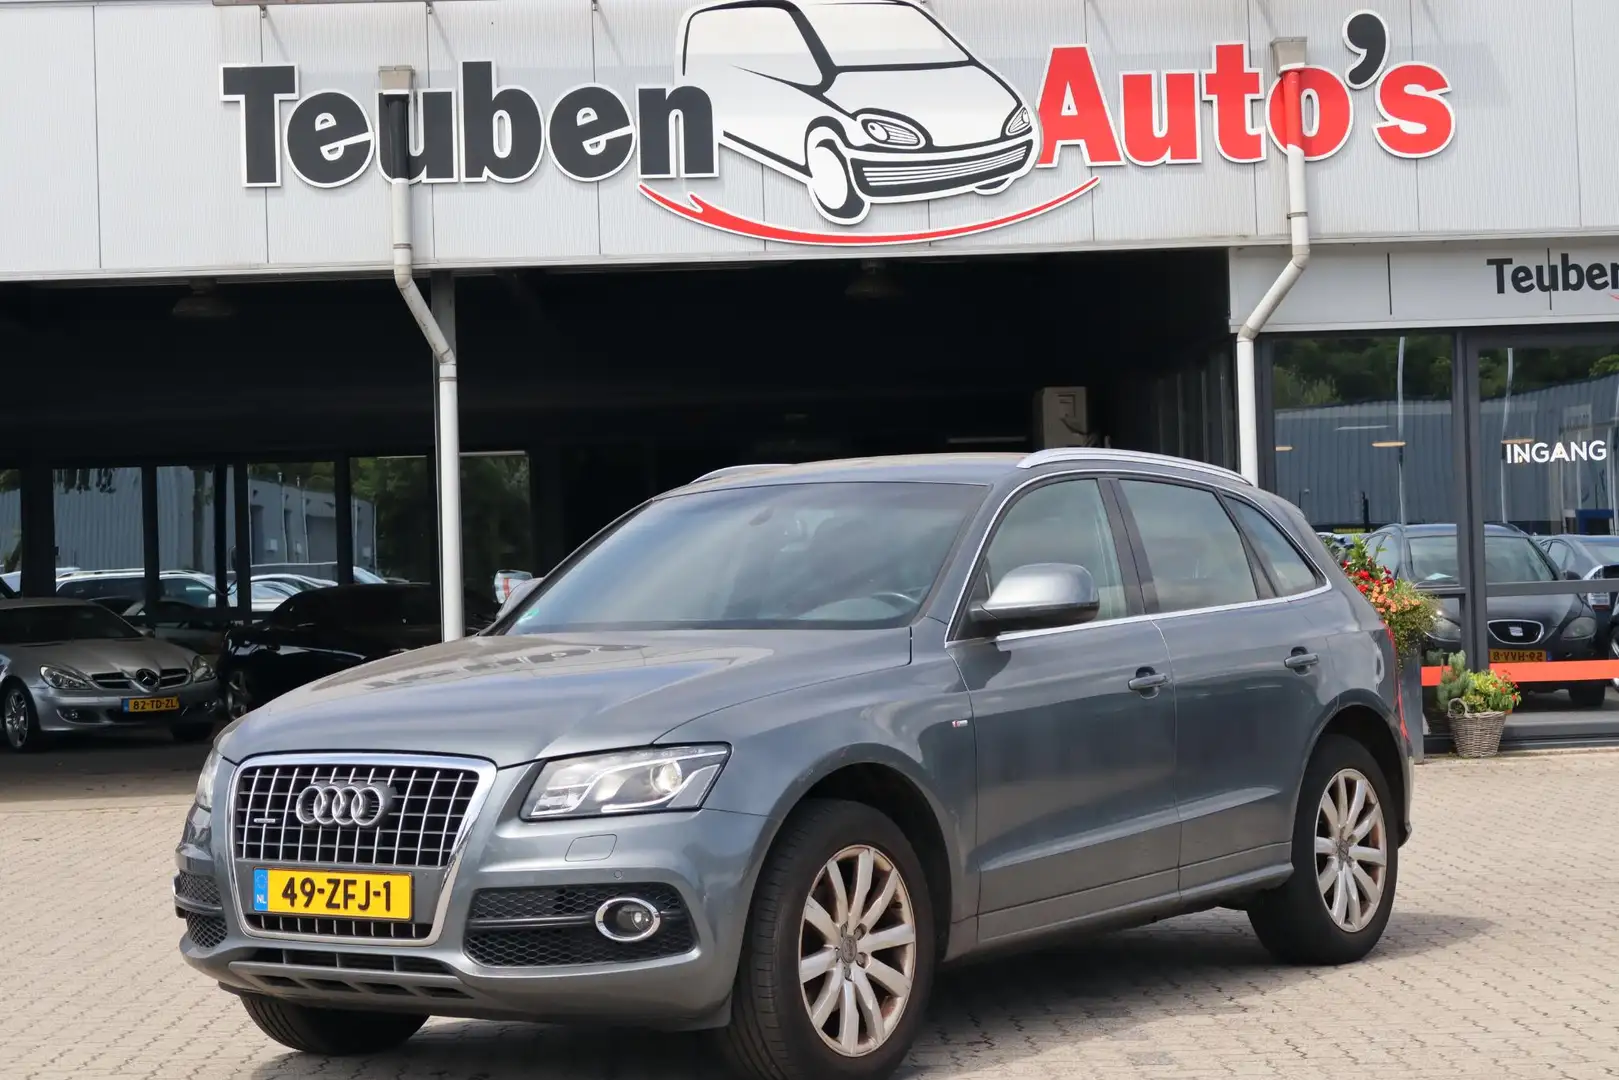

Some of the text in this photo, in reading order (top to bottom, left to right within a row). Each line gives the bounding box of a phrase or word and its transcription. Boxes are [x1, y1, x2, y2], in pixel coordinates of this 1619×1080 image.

[221, 10, 1455, 187] Teuben Auto's
[1506, 440, 1607, 464] INGANG
[133, 699, 176, 710] 82-TD-ZL
[256, 894, 268, 904] NL
[281, 877, 391, 912] 49-ZFJ-1
